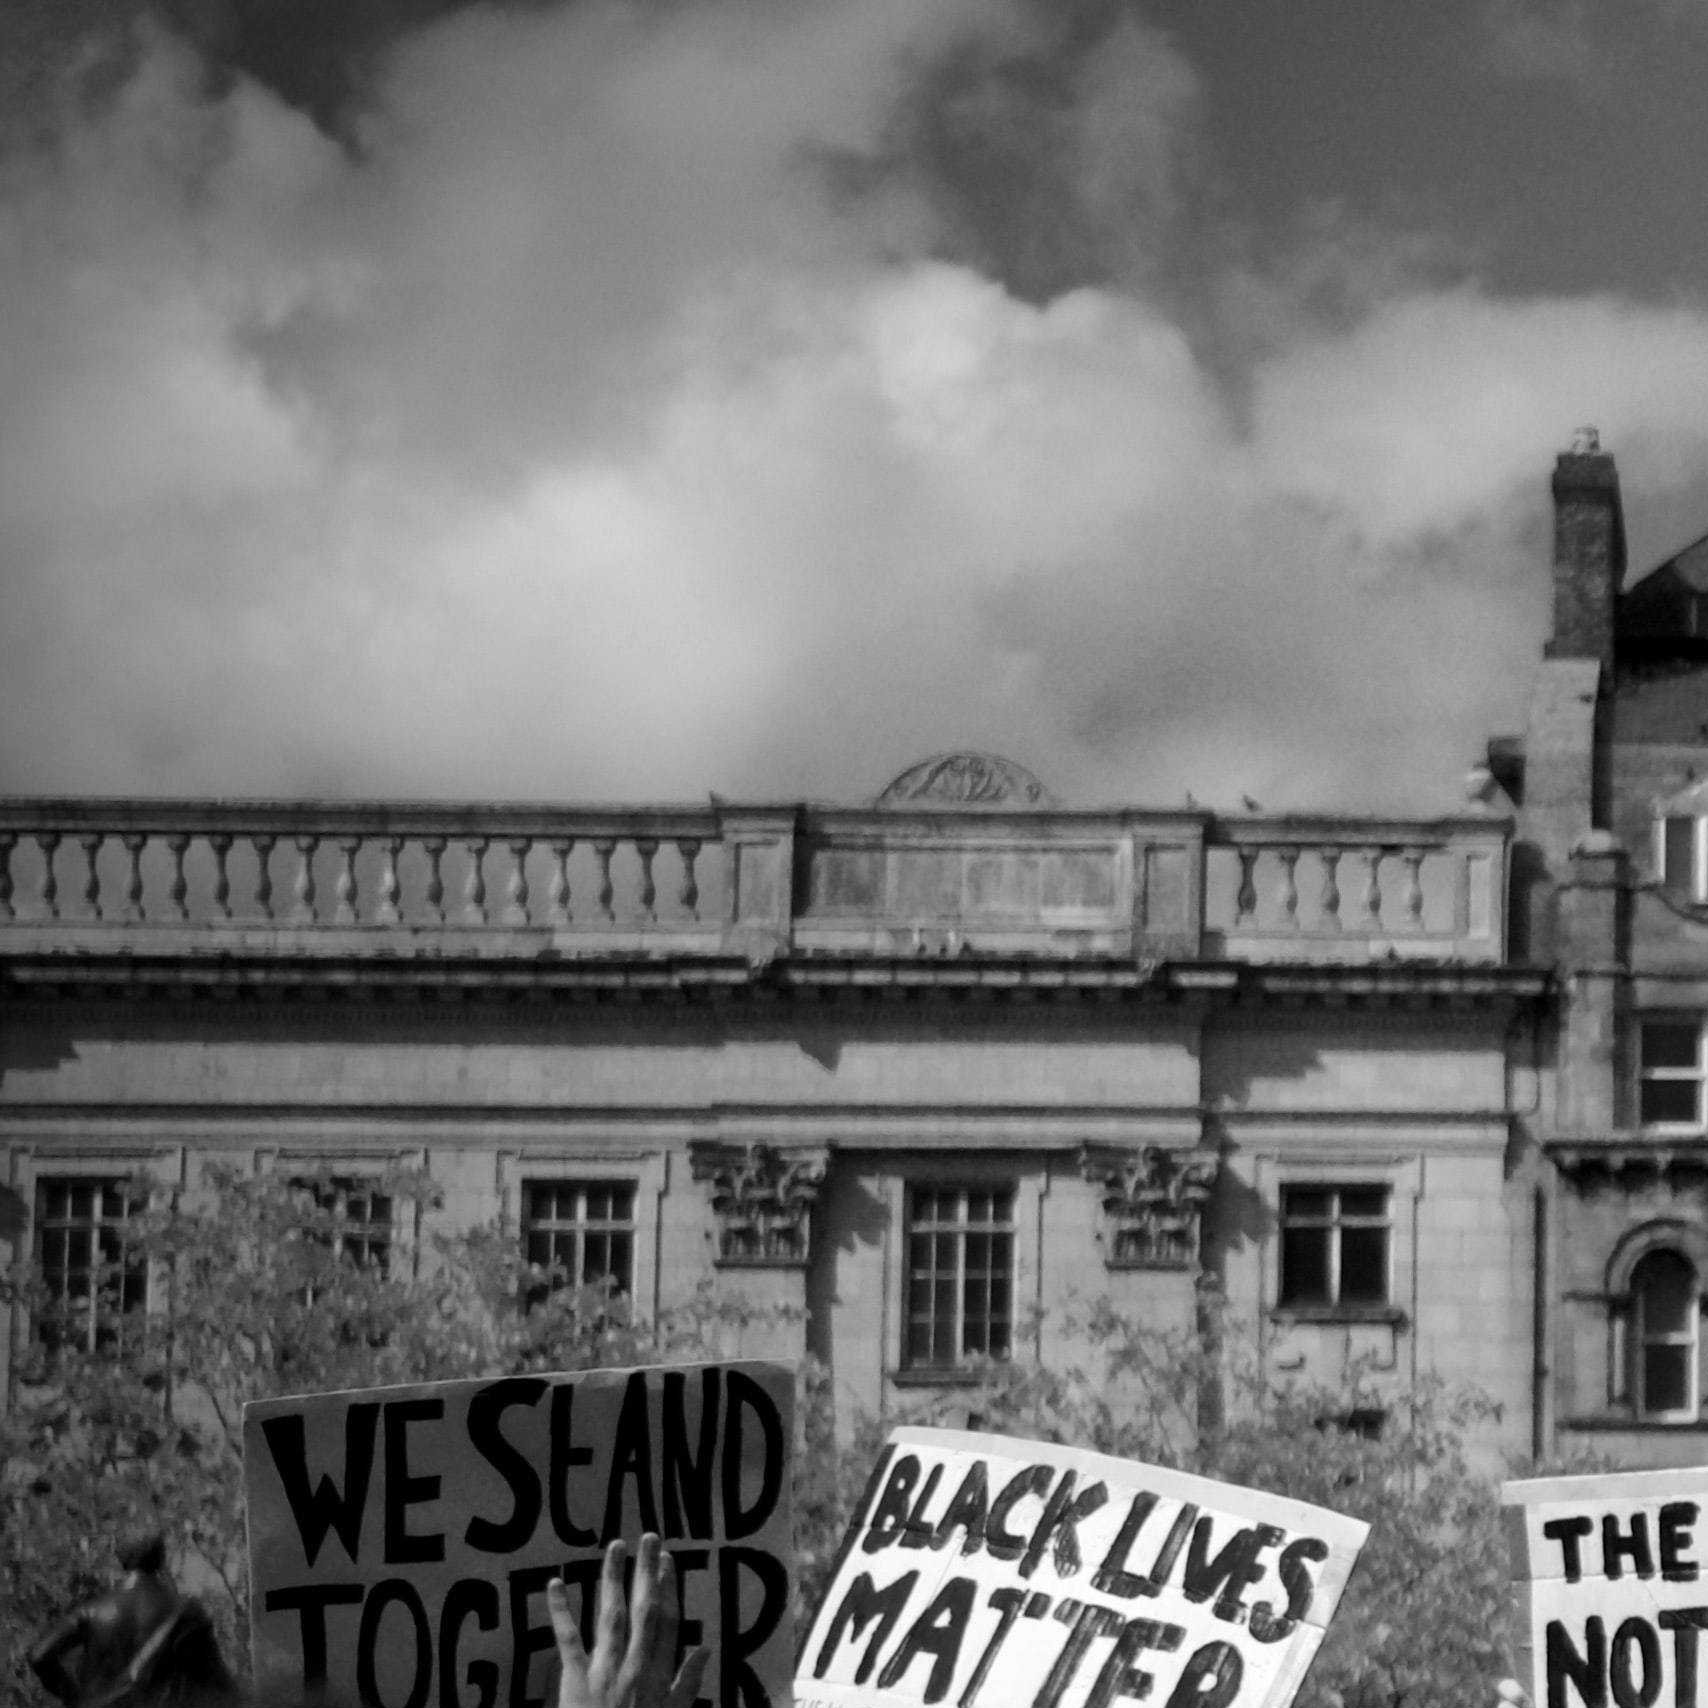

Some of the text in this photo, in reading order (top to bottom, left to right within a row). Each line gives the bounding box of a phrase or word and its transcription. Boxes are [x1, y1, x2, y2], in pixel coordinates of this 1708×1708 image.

[261, 1398, 445, 1568] WE
[861, 1453, 1330, 1643] BLACK LIVES
[1544, 1501, 1700, 1582] THE
